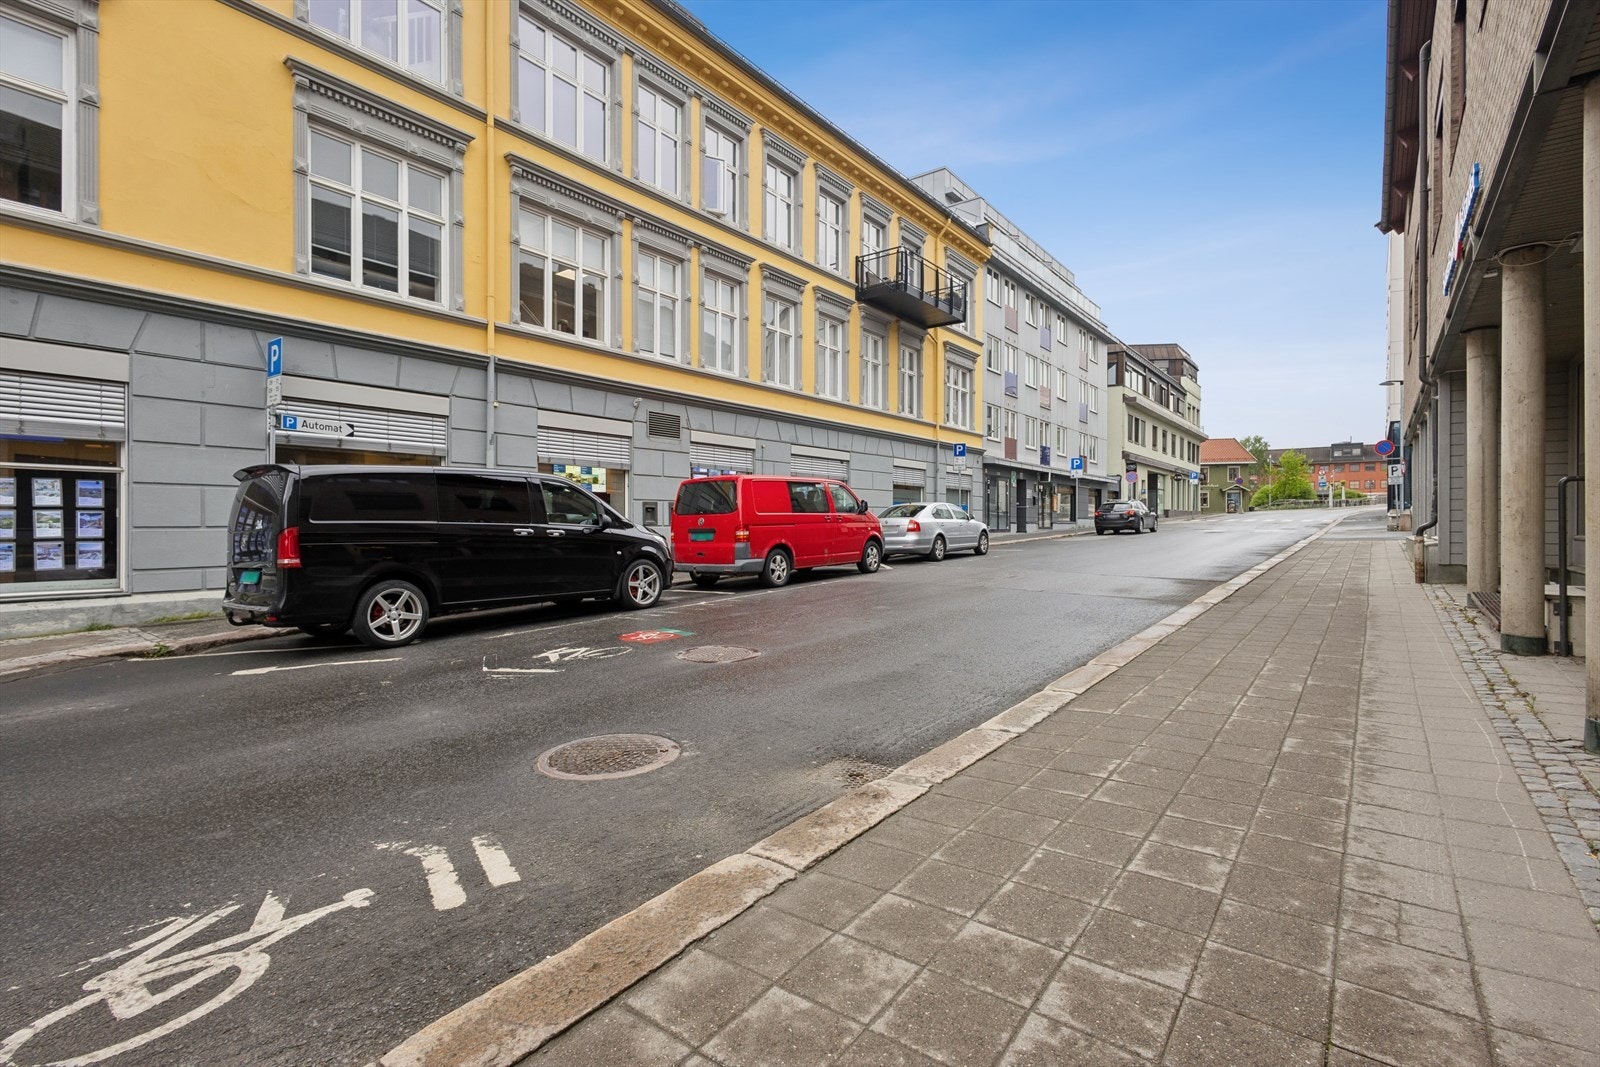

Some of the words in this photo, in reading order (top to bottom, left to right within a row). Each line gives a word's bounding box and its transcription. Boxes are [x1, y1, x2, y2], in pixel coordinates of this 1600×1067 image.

[271, 344, 279, 373] P
[286, 417, 295, 428] P
[301, 419, 343, 433] Automat
[956, 444, 964, 456] P
[1073, 459, 1081, 469] P
[1391, 466, 1399, 476] P
